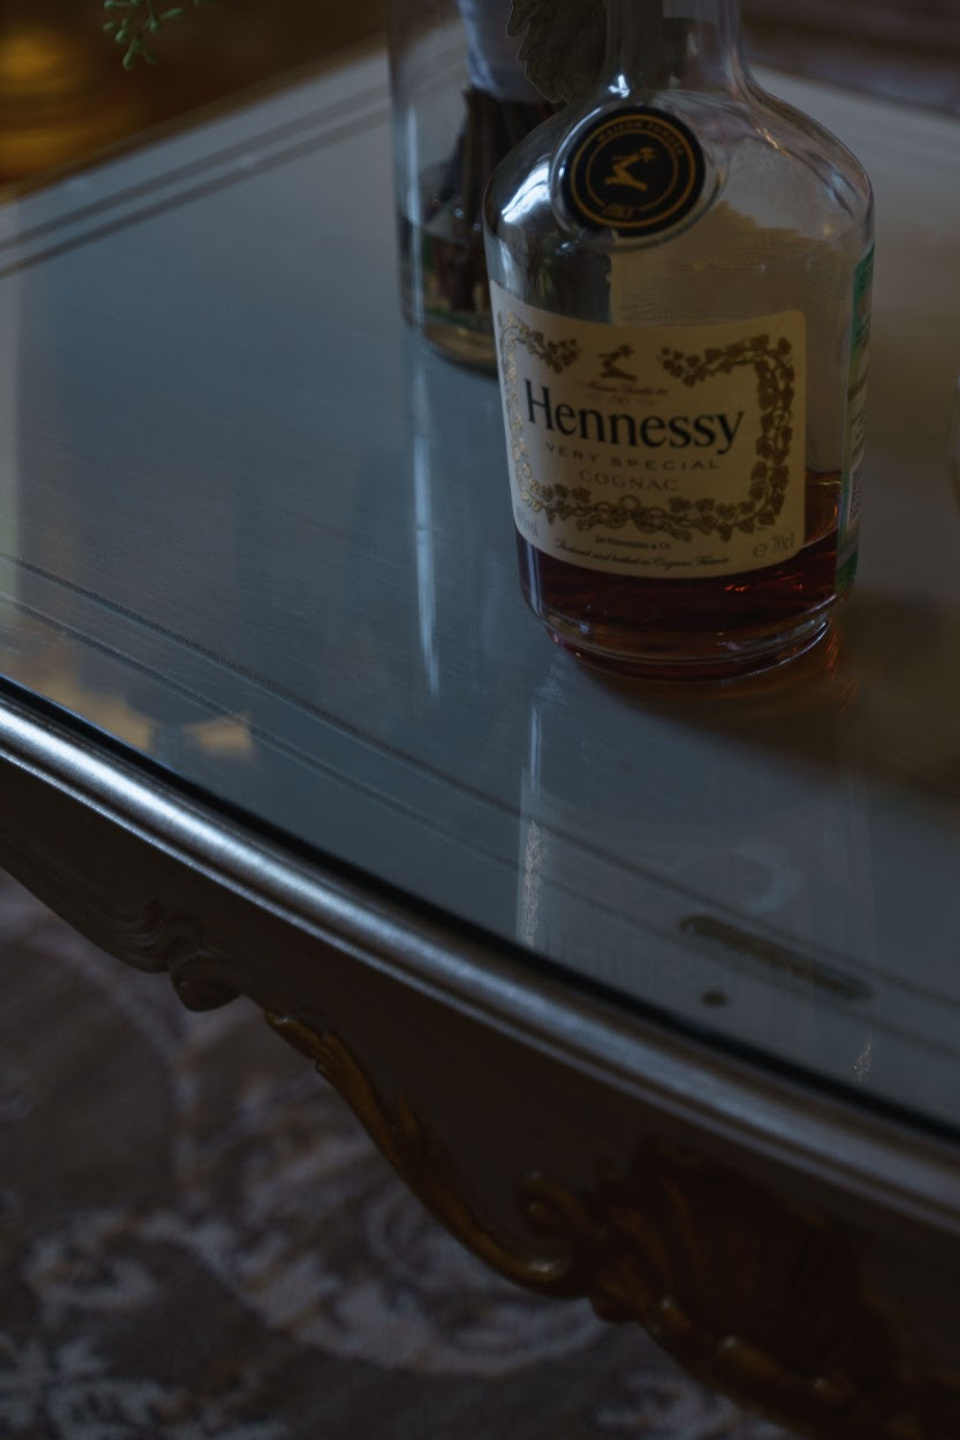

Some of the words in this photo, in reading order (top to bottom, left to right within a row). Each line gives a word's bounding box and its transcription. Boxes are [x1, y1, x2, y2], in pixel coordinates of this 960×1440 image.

[523, 379, 744, 455] Hennessy
[545, 441, 599, 463] VERY
[611, 456, 719, 471] SPECIAL
[578, 469, 679, 492] COGNAC
